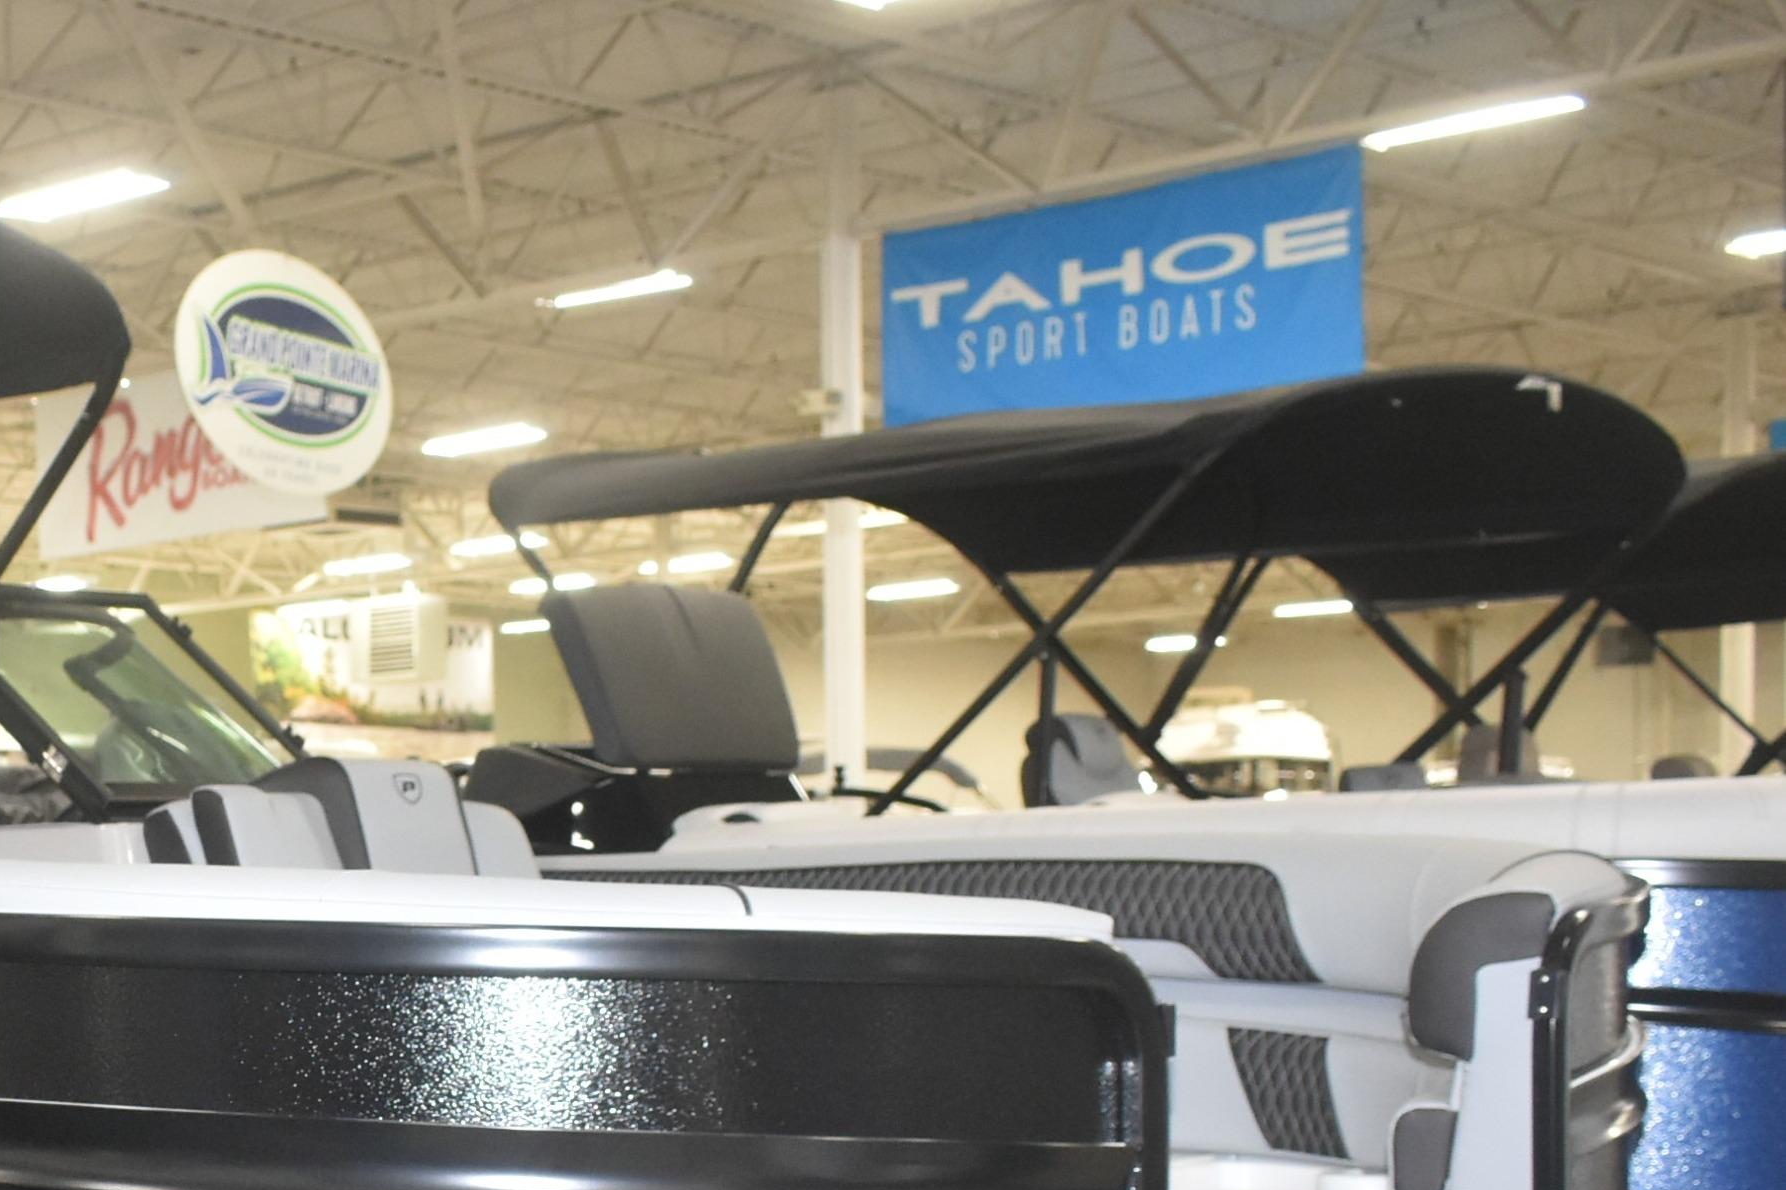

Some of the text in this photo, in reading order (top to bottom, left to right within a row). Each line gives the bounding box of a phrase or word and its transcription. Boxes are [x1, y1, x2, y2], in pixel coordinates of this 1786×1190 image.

[890, 208, 1352, 329] TAHOE
[957, 283, 1257, 374] SPORT BOATS
